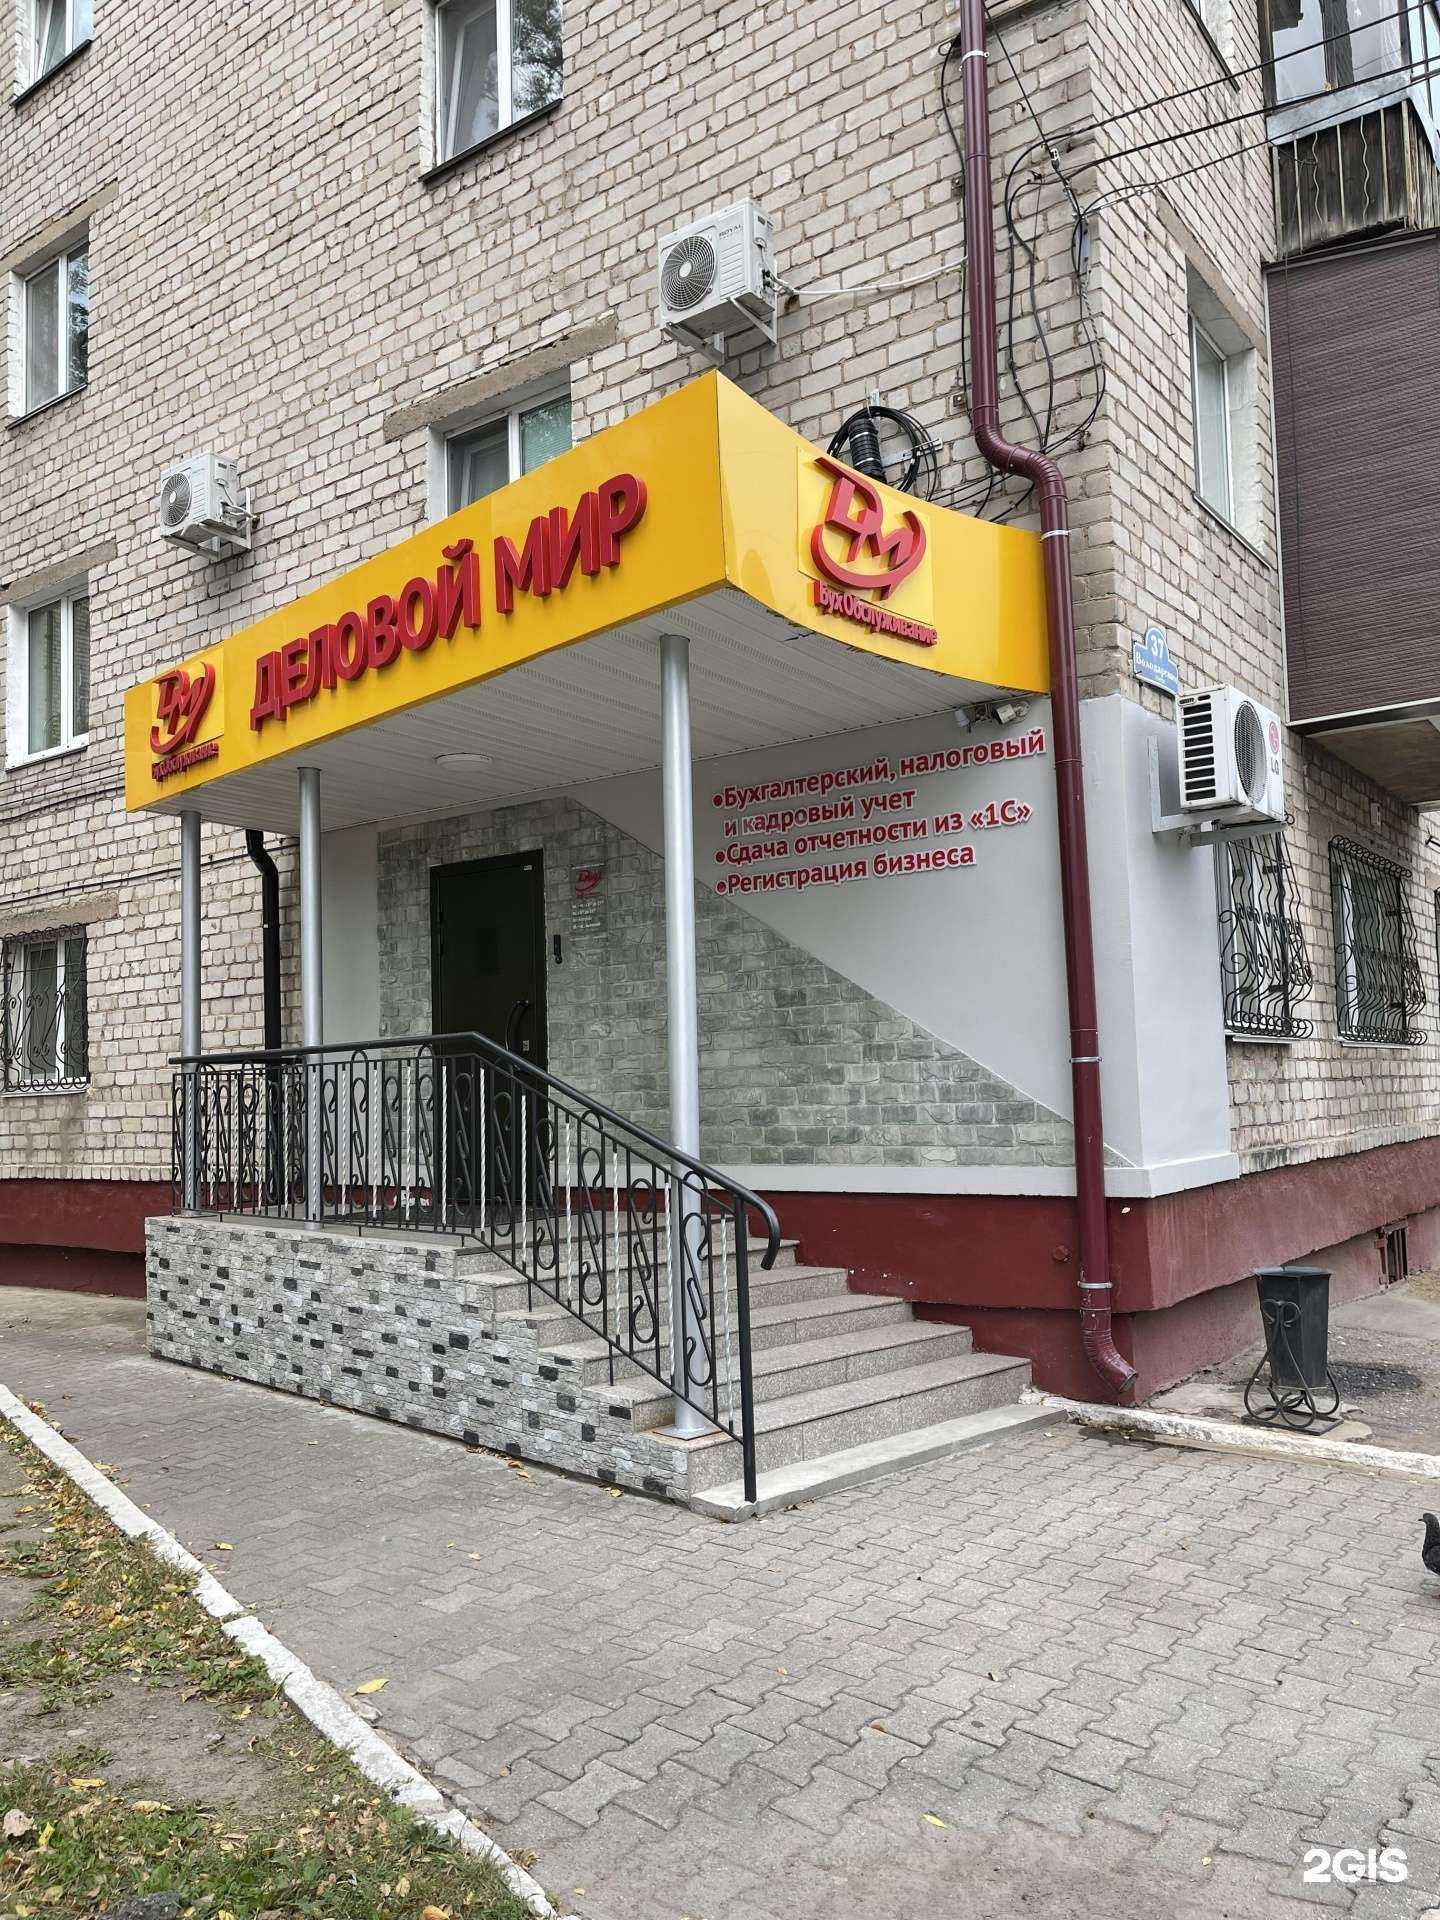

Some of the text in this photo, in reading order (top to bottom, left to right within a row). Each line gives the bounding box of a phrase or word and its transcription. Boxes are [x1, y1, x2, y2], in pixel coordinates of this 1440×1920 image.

[249, 473, 648, 732] ДЕЛОВОЙ МИР
[1150, 634, 1164, 660] 37
[724, 728, 1046, 808] Бухгалтерский, налоговый
[1271, 757, 1280, 776] LG
[724, 789, 916, 838] и кадровый учет
[726, 839, 788, 866] Сдача
[794, 819, 928, 855] отчетности
[934, 810, 963, 833] из
[728, 844, 976, 895] Регистрация бизнеса
